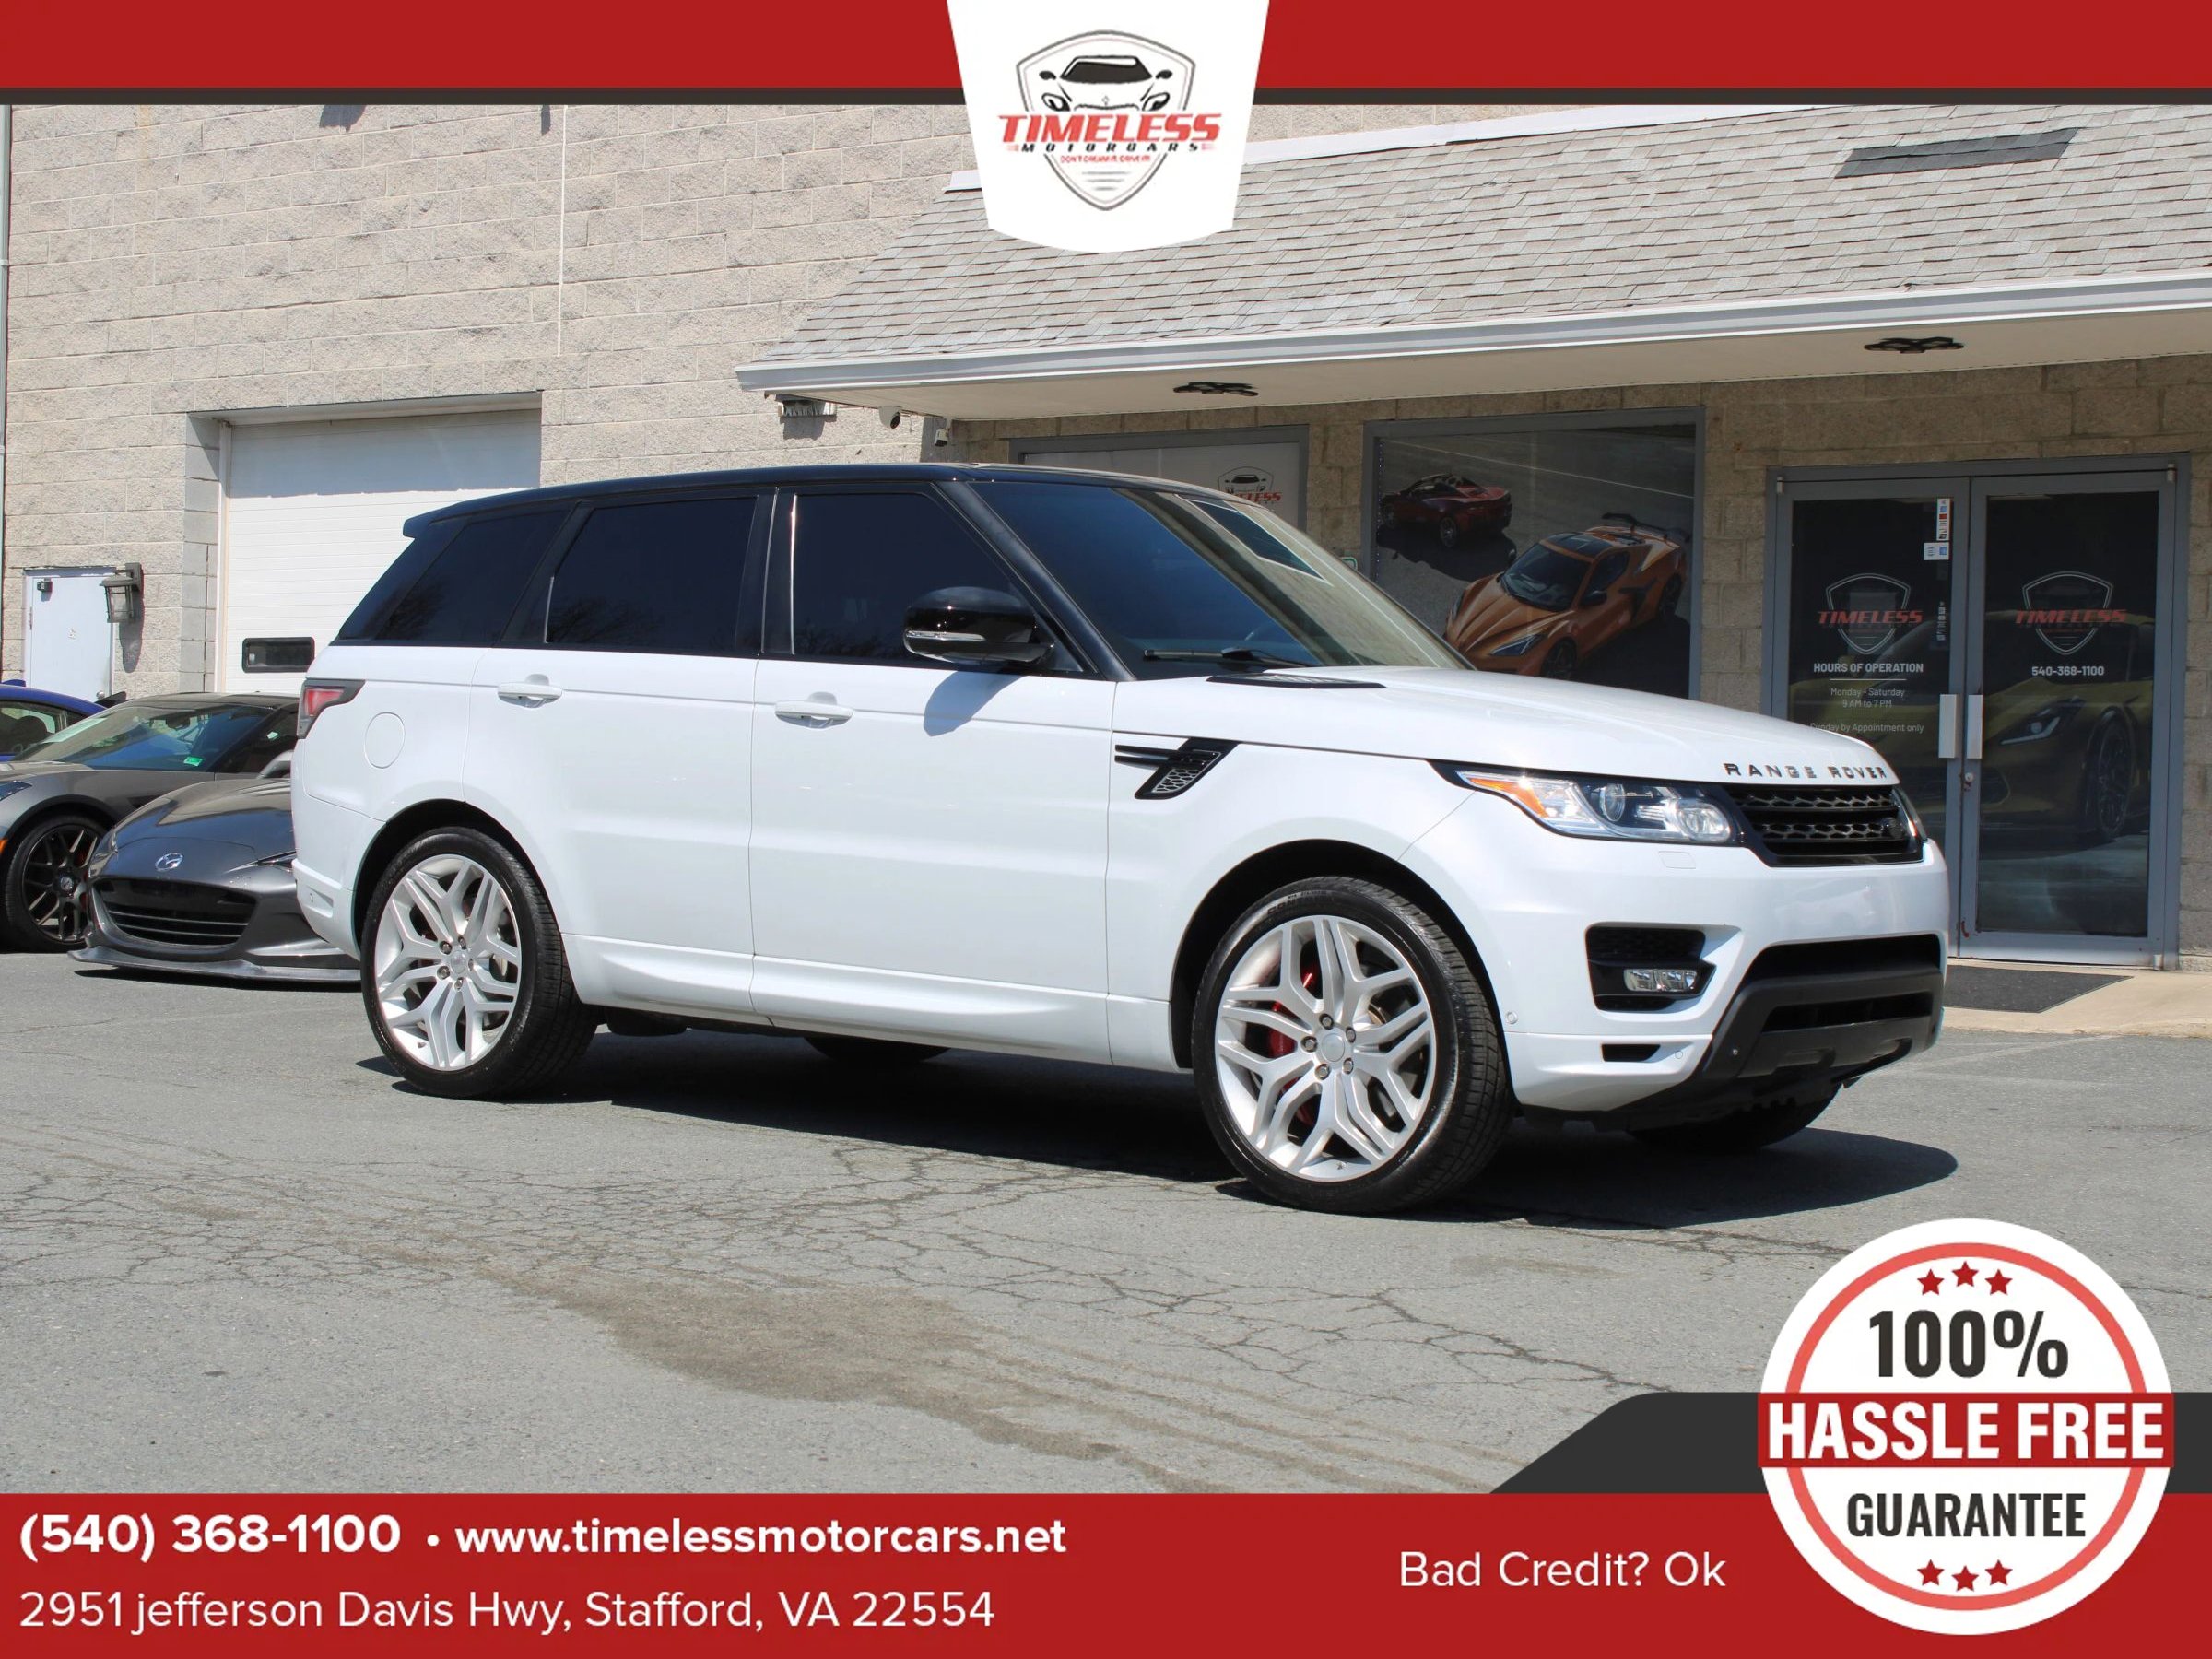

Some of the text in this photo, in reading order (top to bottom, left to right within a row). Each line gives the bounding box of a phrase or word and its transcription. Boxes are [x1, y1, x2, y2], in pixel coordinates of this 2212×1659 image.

[1818, 610, 1924, 624] TIMELESS
[2016, 608, 2127, 624] TIMELESS
[1813, 663, 1924, 673] HOURS OF OPERATION
[2031, 665, 2105, 677] 540-368-1100
[1830, 688, 1862, 698] Monday
[1868, 688, 1906, 698] Saturday
[1849, 700, 1862, 708] AM
[1873, 700, 1878, 708] 7
[1879, 700, 1892, 708] PM
[1841, 722, 1851, 734] by
[1852, 723, 1905, 734] Appointment
[1907, 723, 1924, 734] only
[1723, 763, 1888, 779] RANGE ROVER
